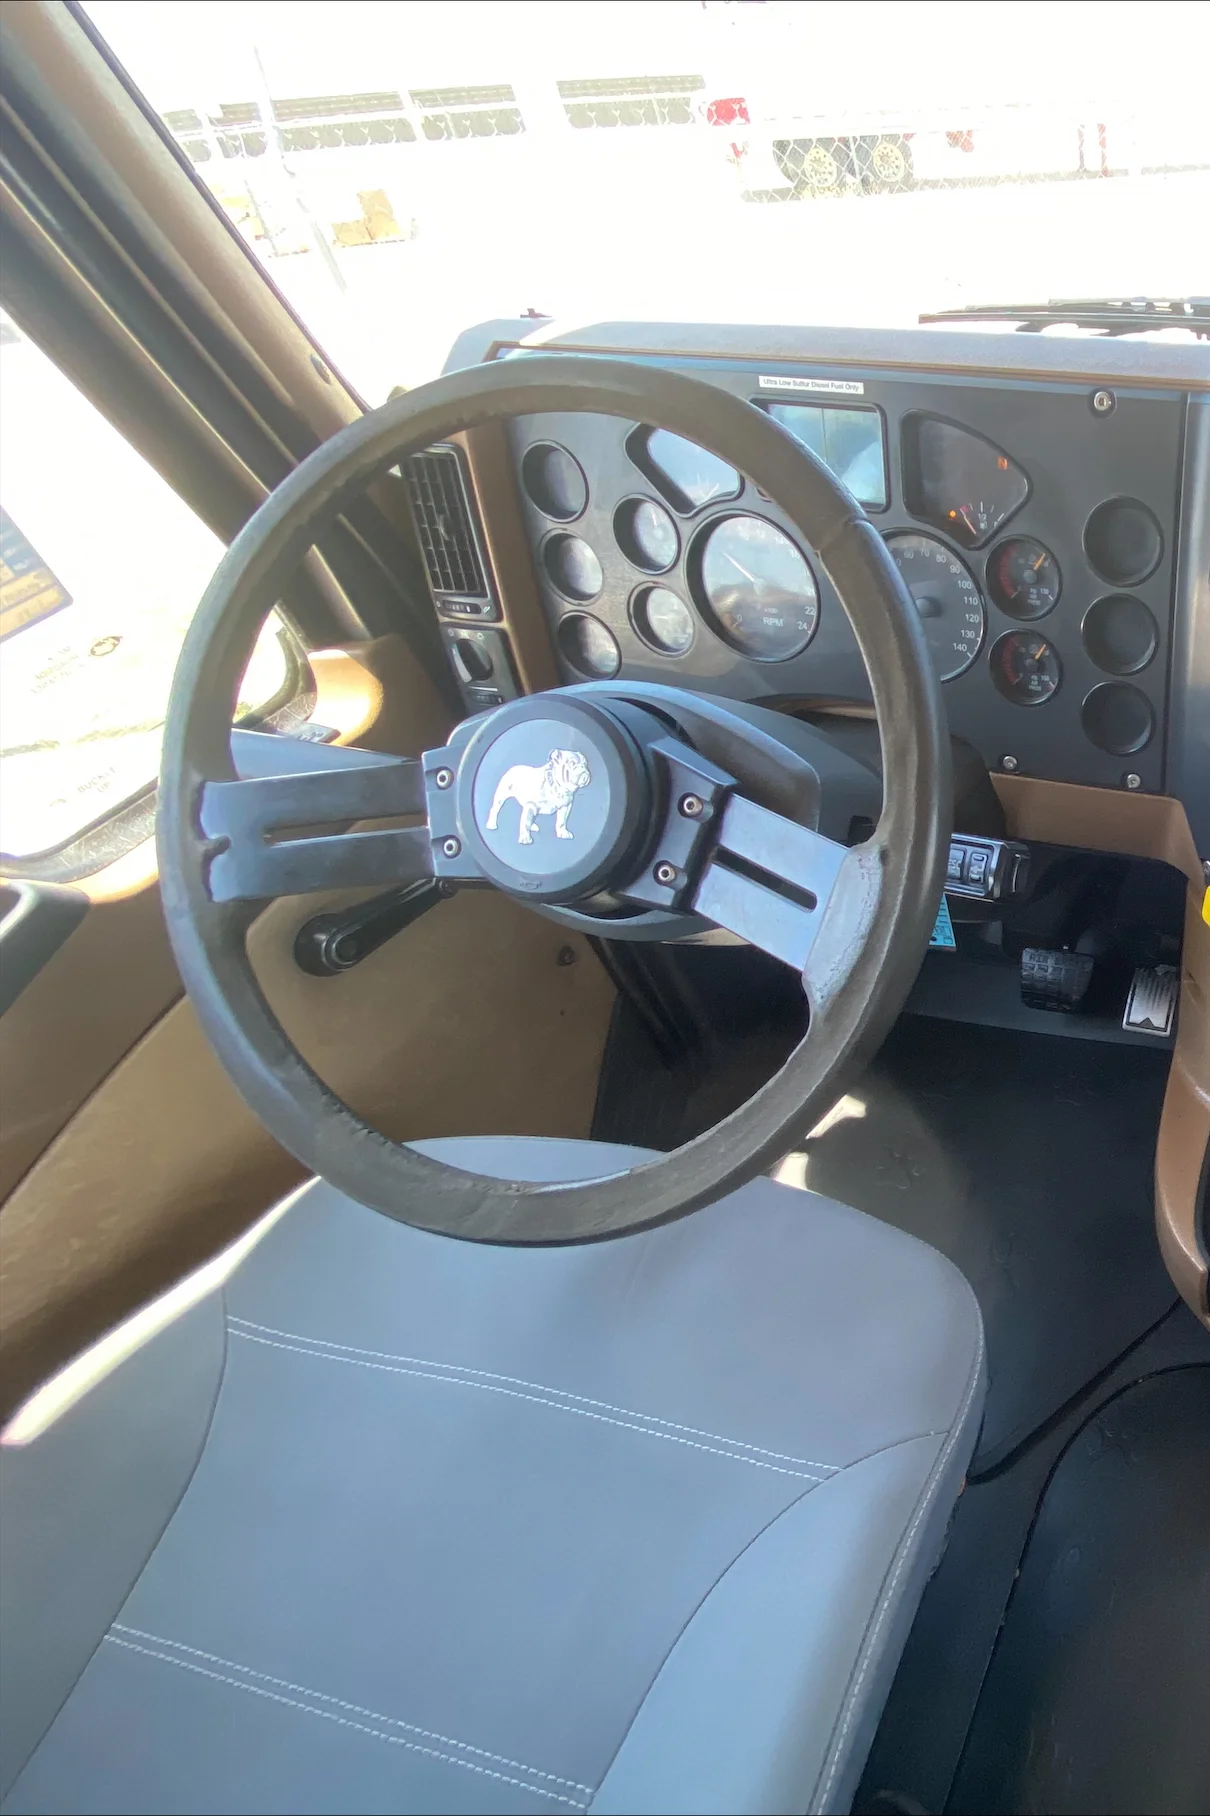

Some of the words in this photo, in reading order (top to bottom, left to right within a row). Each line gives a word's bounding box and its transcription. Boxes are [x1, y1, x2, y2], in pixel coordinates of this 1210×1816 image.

[763, 378, 778, 386] Ultra
[792, 380, 810, 388] Sulfur
[811, 381, 830, 389] Diesel
[845, 383, 859, 391] Only
[904, 551, 914, 559] 60
[920, 549, 930, 557] 70
[936, 554, 947, 563] 80
[950, 565, 961, 574] 90
[957, 580, 972, 589] 100
[963, 597, 978, 606] 110
[805, 606, 816, 616] 22
[763, 616, 784, 627] RPM
[965, 613, 980, 623] 120
[797, 621, 808, 630] 24
[960, 630, 975, 639] 130
[953, 642, 968, 652] 140
